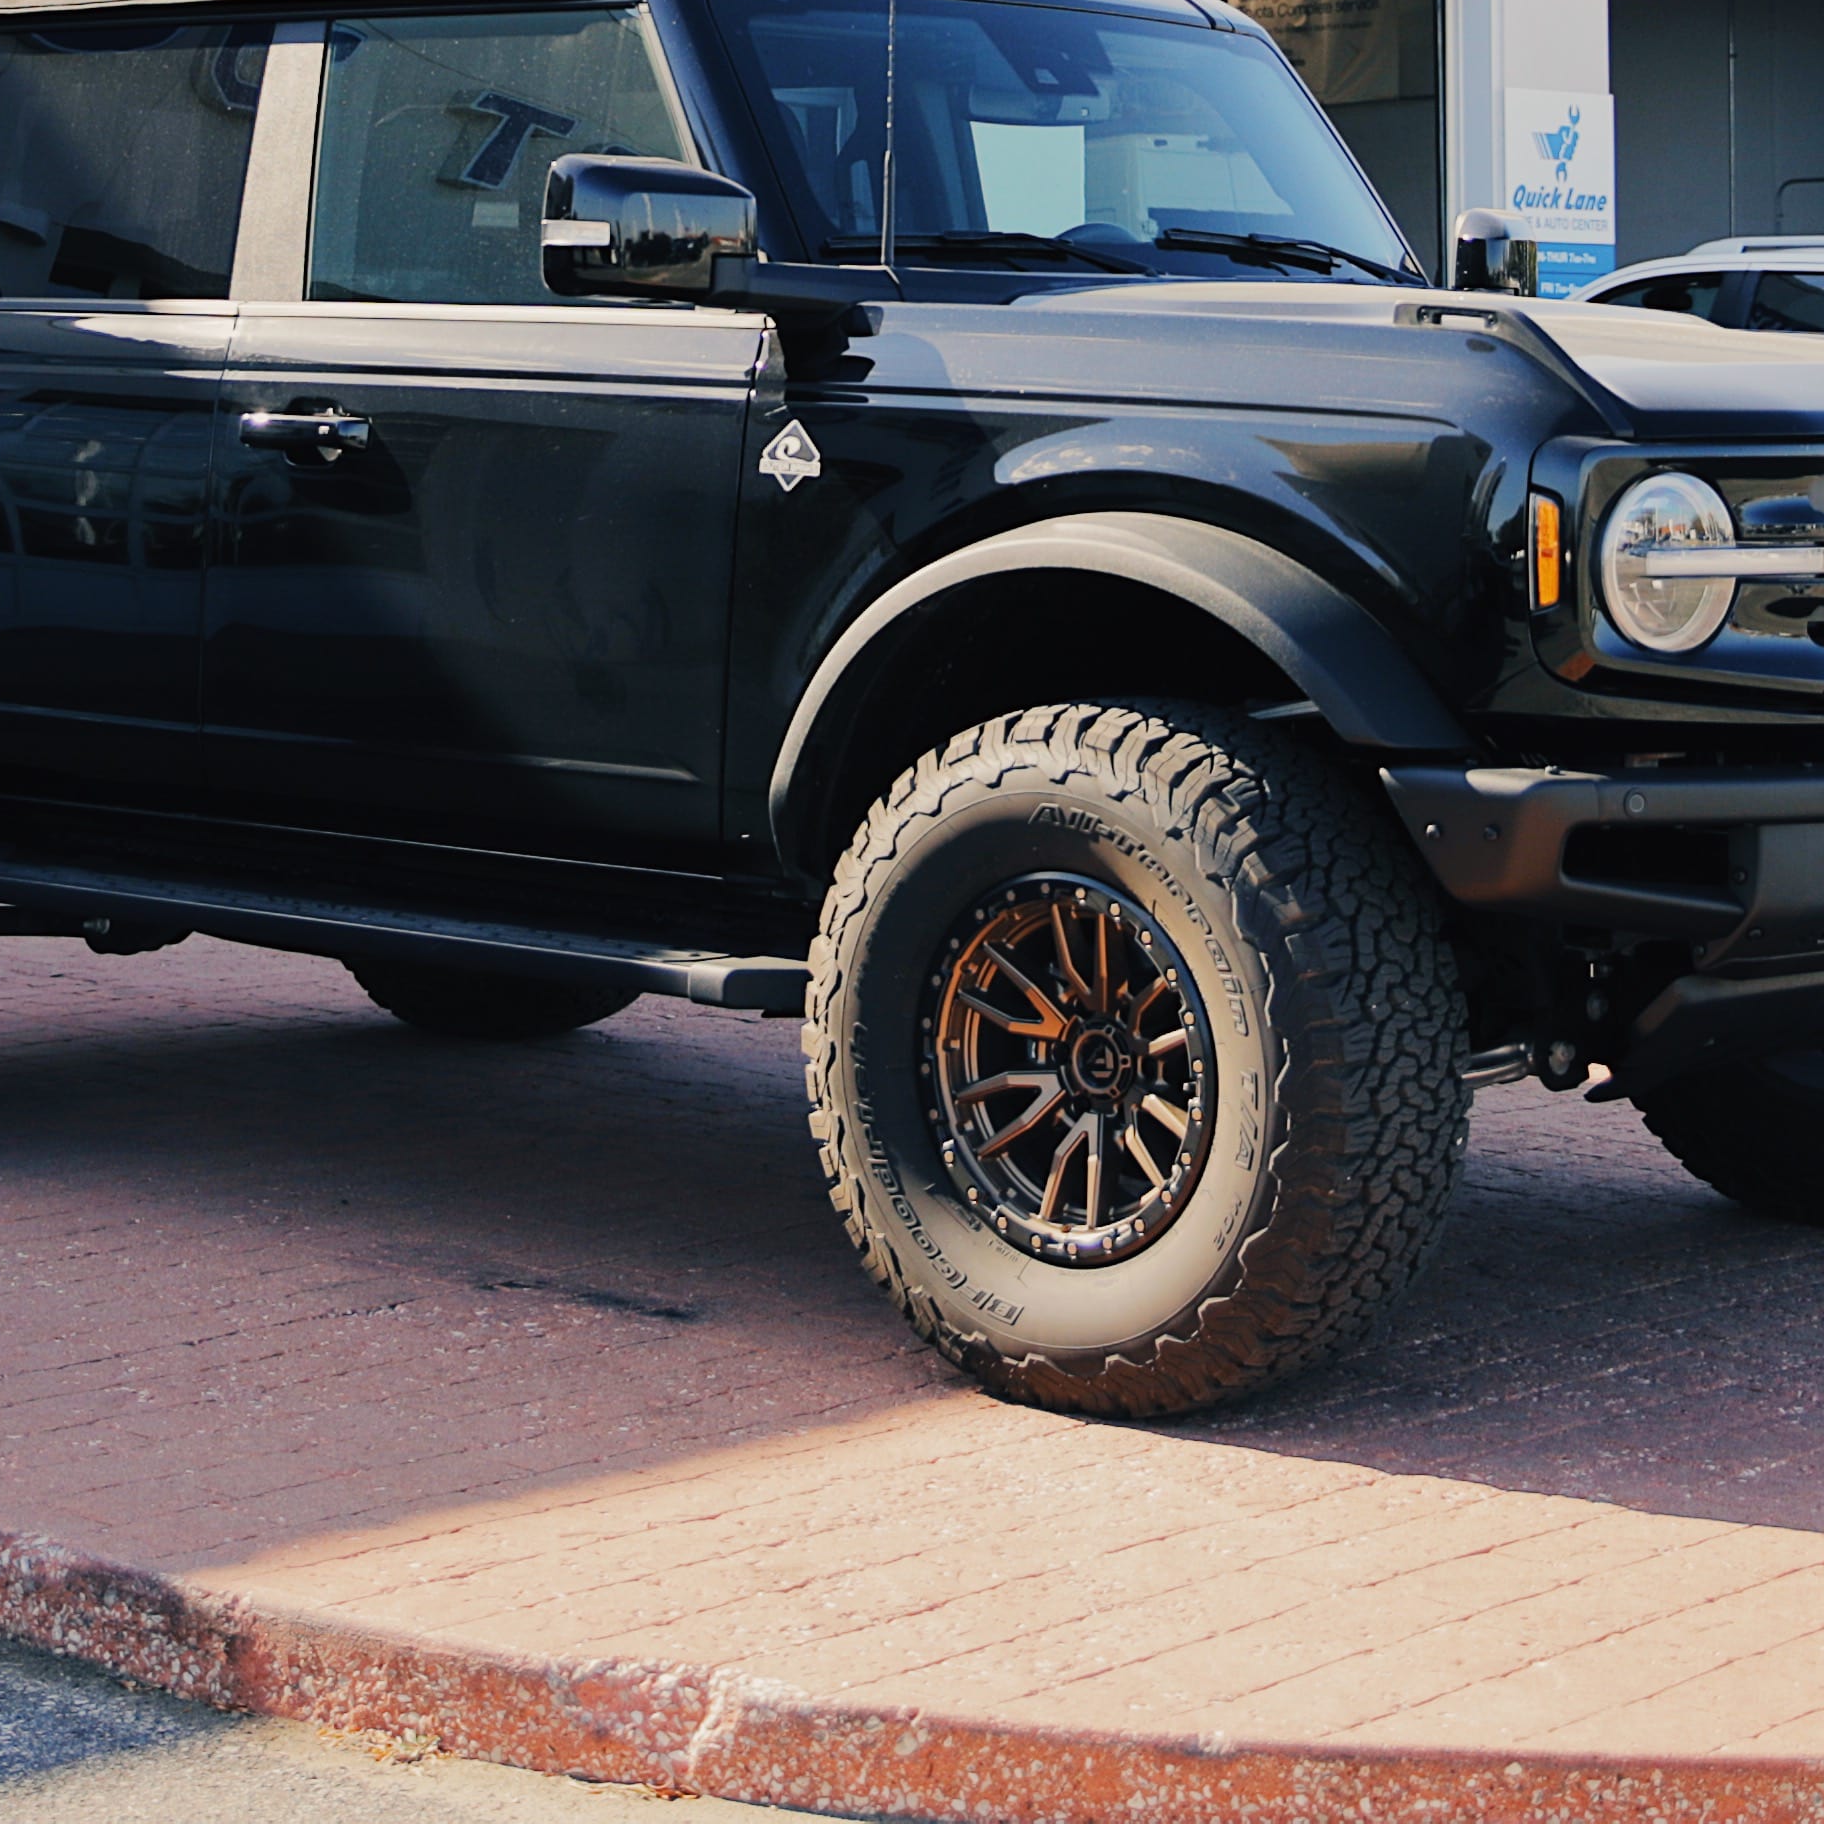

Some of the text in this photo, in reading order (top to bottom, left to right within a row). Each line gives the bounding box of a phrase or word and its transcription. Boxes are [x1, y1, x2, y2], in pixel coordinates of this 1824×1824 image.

[1513, 184, 1608, 212] Quick Lane
[1544, 217, 1569, 230] AUTO
[1572, 218, 1608, 232] CENTER
[1028, 802, 1249, 1036] All-Terrain
[1235, 1068, 1259, 1172] T/A
